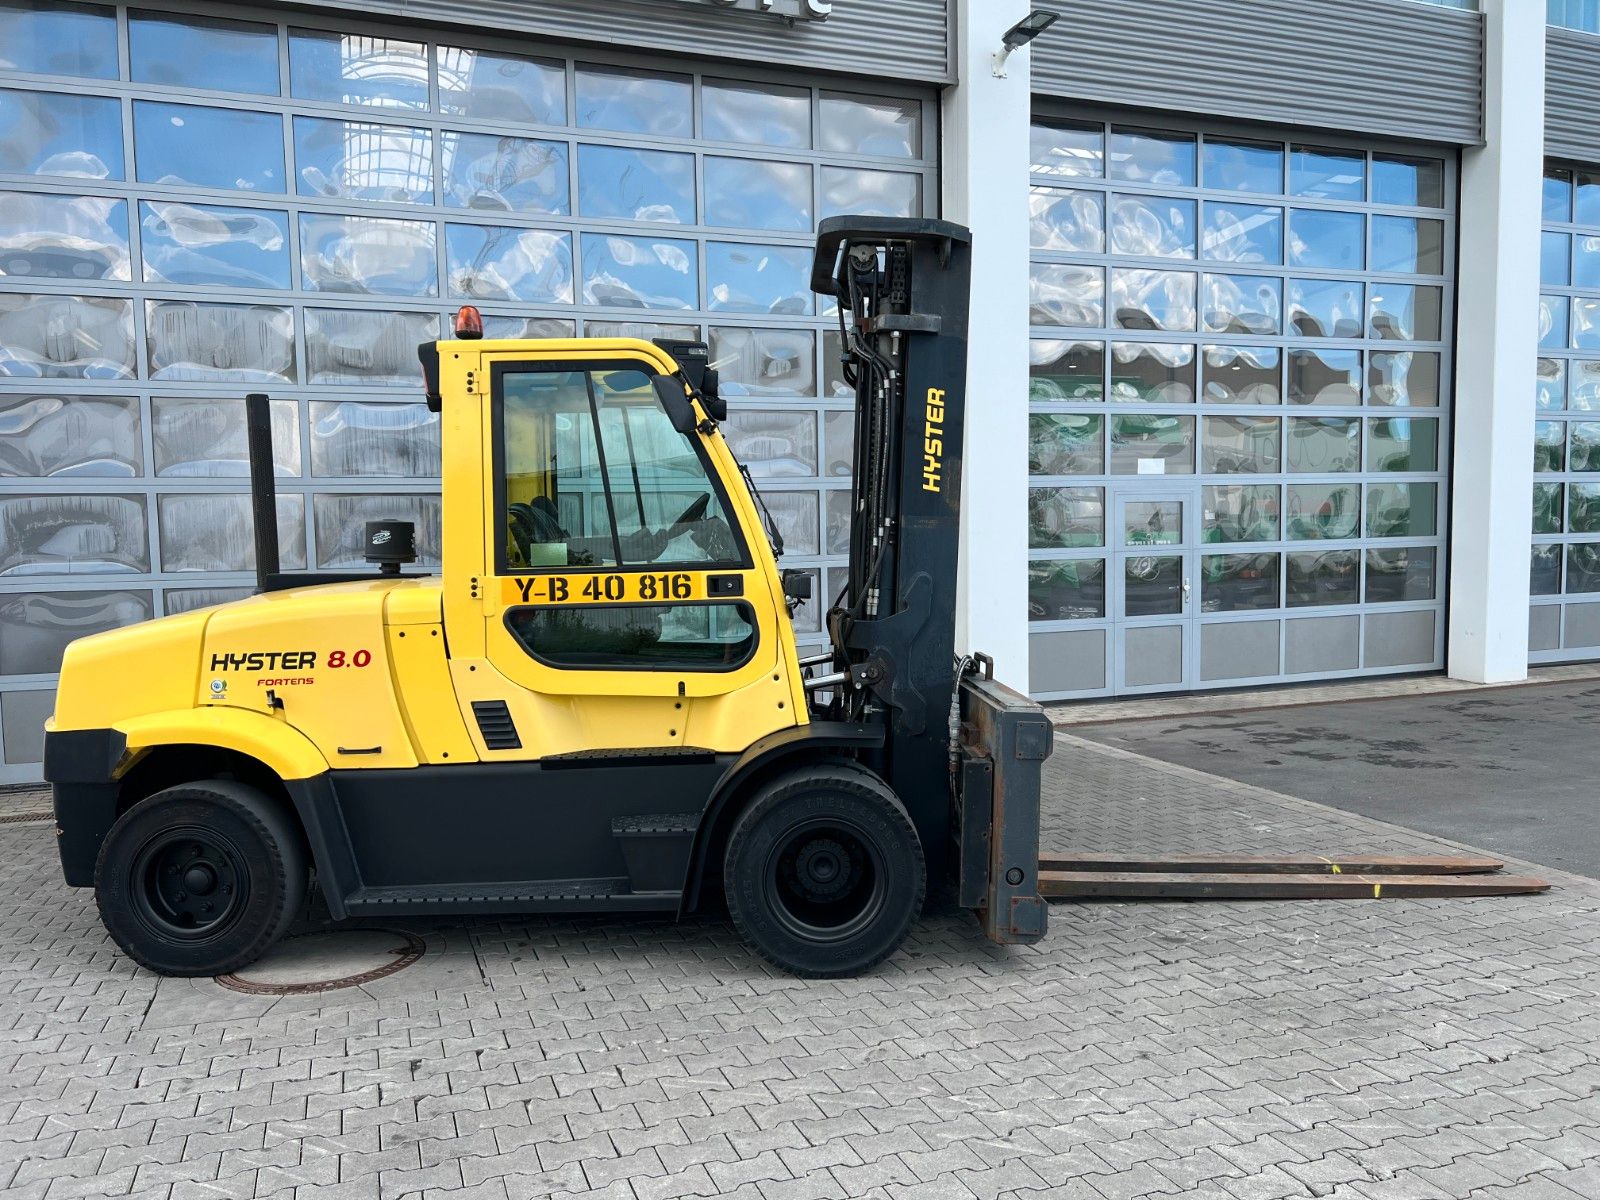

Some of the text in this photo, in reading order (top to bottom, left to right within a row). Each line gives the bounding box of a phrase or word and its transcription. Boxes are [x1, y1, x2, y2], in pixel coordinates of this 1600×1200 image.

[922, 387, 945, 492] HYSTER
[515, 574, 691, 602] Y-B 40 816
[210, 650, 371, 671] HYSTER 8.0
[257, 677, 314, 686] FORTENS
